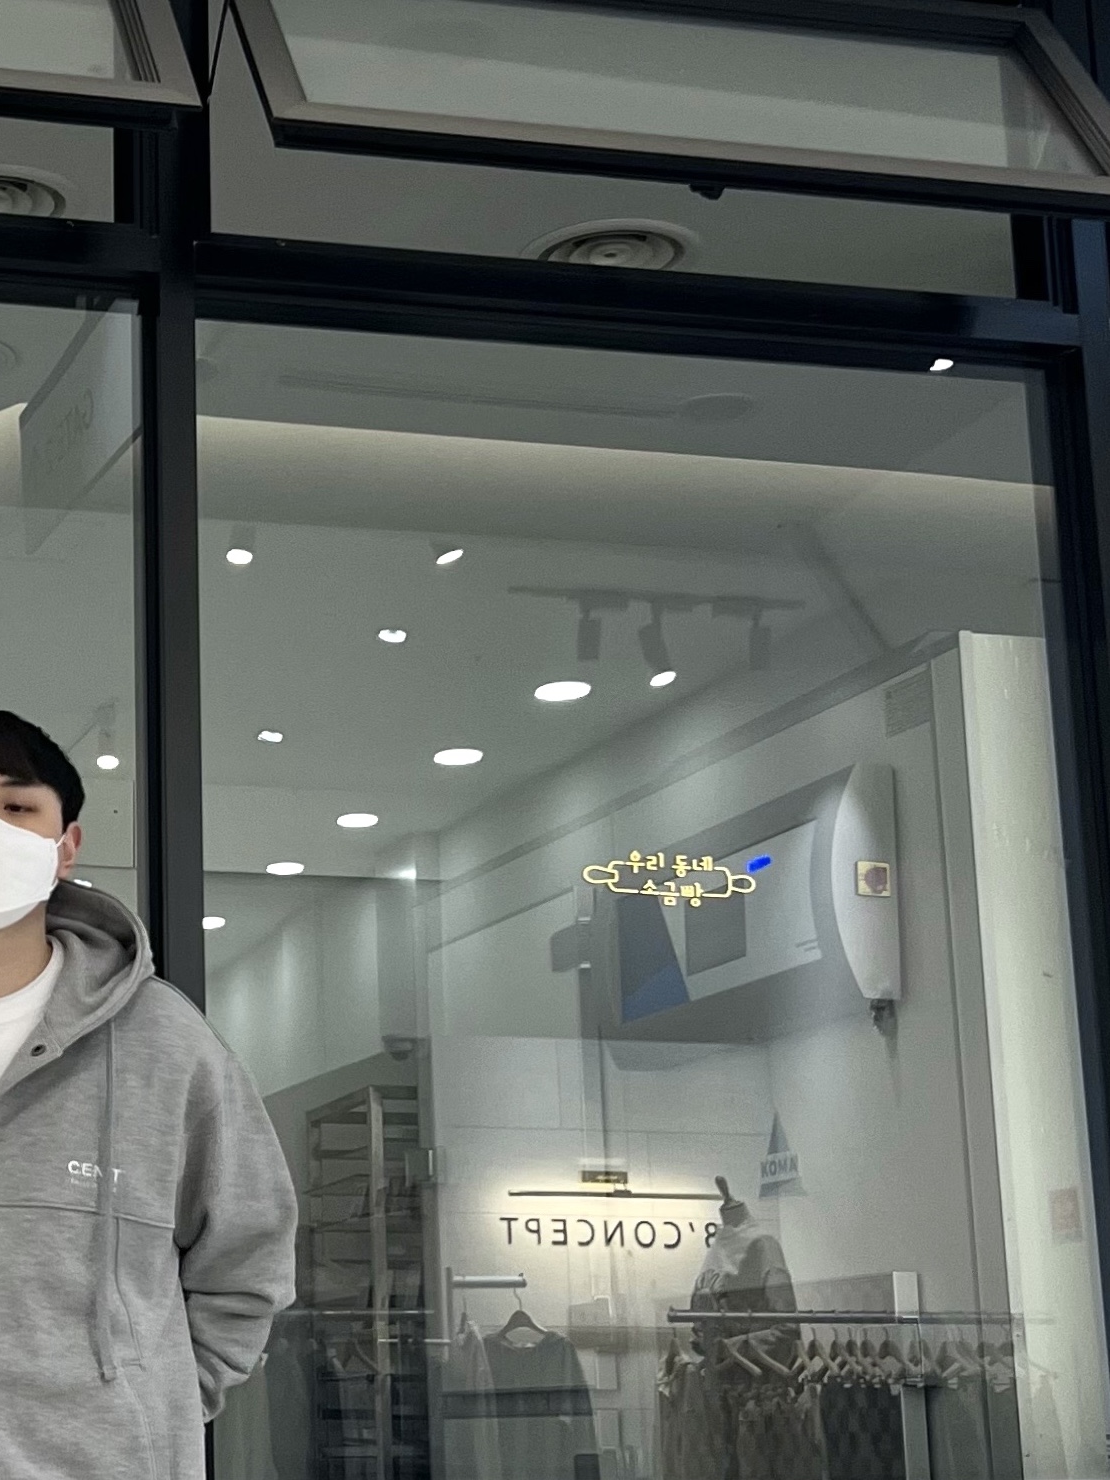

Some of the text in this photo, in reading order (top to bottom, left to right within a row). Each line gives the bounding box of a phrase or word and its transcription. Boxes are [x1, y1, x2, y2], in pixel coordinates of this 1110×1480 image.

[625, 850, 713, 878] 우리 동네
[640, 879, 704, 907] 소금빵
